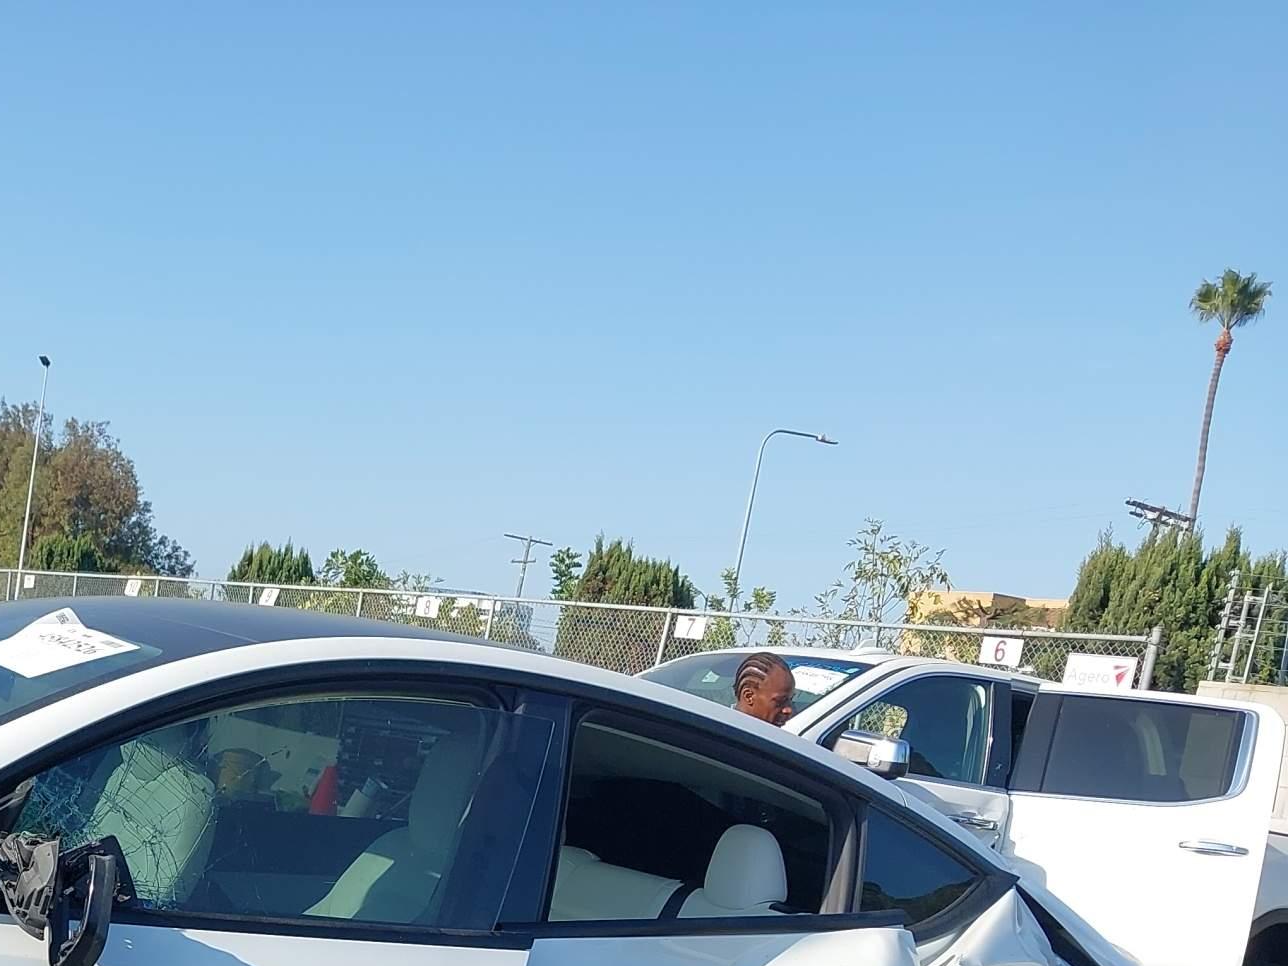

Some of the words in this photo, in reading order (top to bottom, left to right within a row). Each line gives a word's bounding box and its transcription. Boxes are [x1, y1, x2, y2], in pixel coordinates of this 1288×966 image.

[423, 599, 431, 615] 8
[686, 617, 697, 637] 7
[994, 640, 1007, 662] 6
[1067, 669, 1110, 686] Agero
